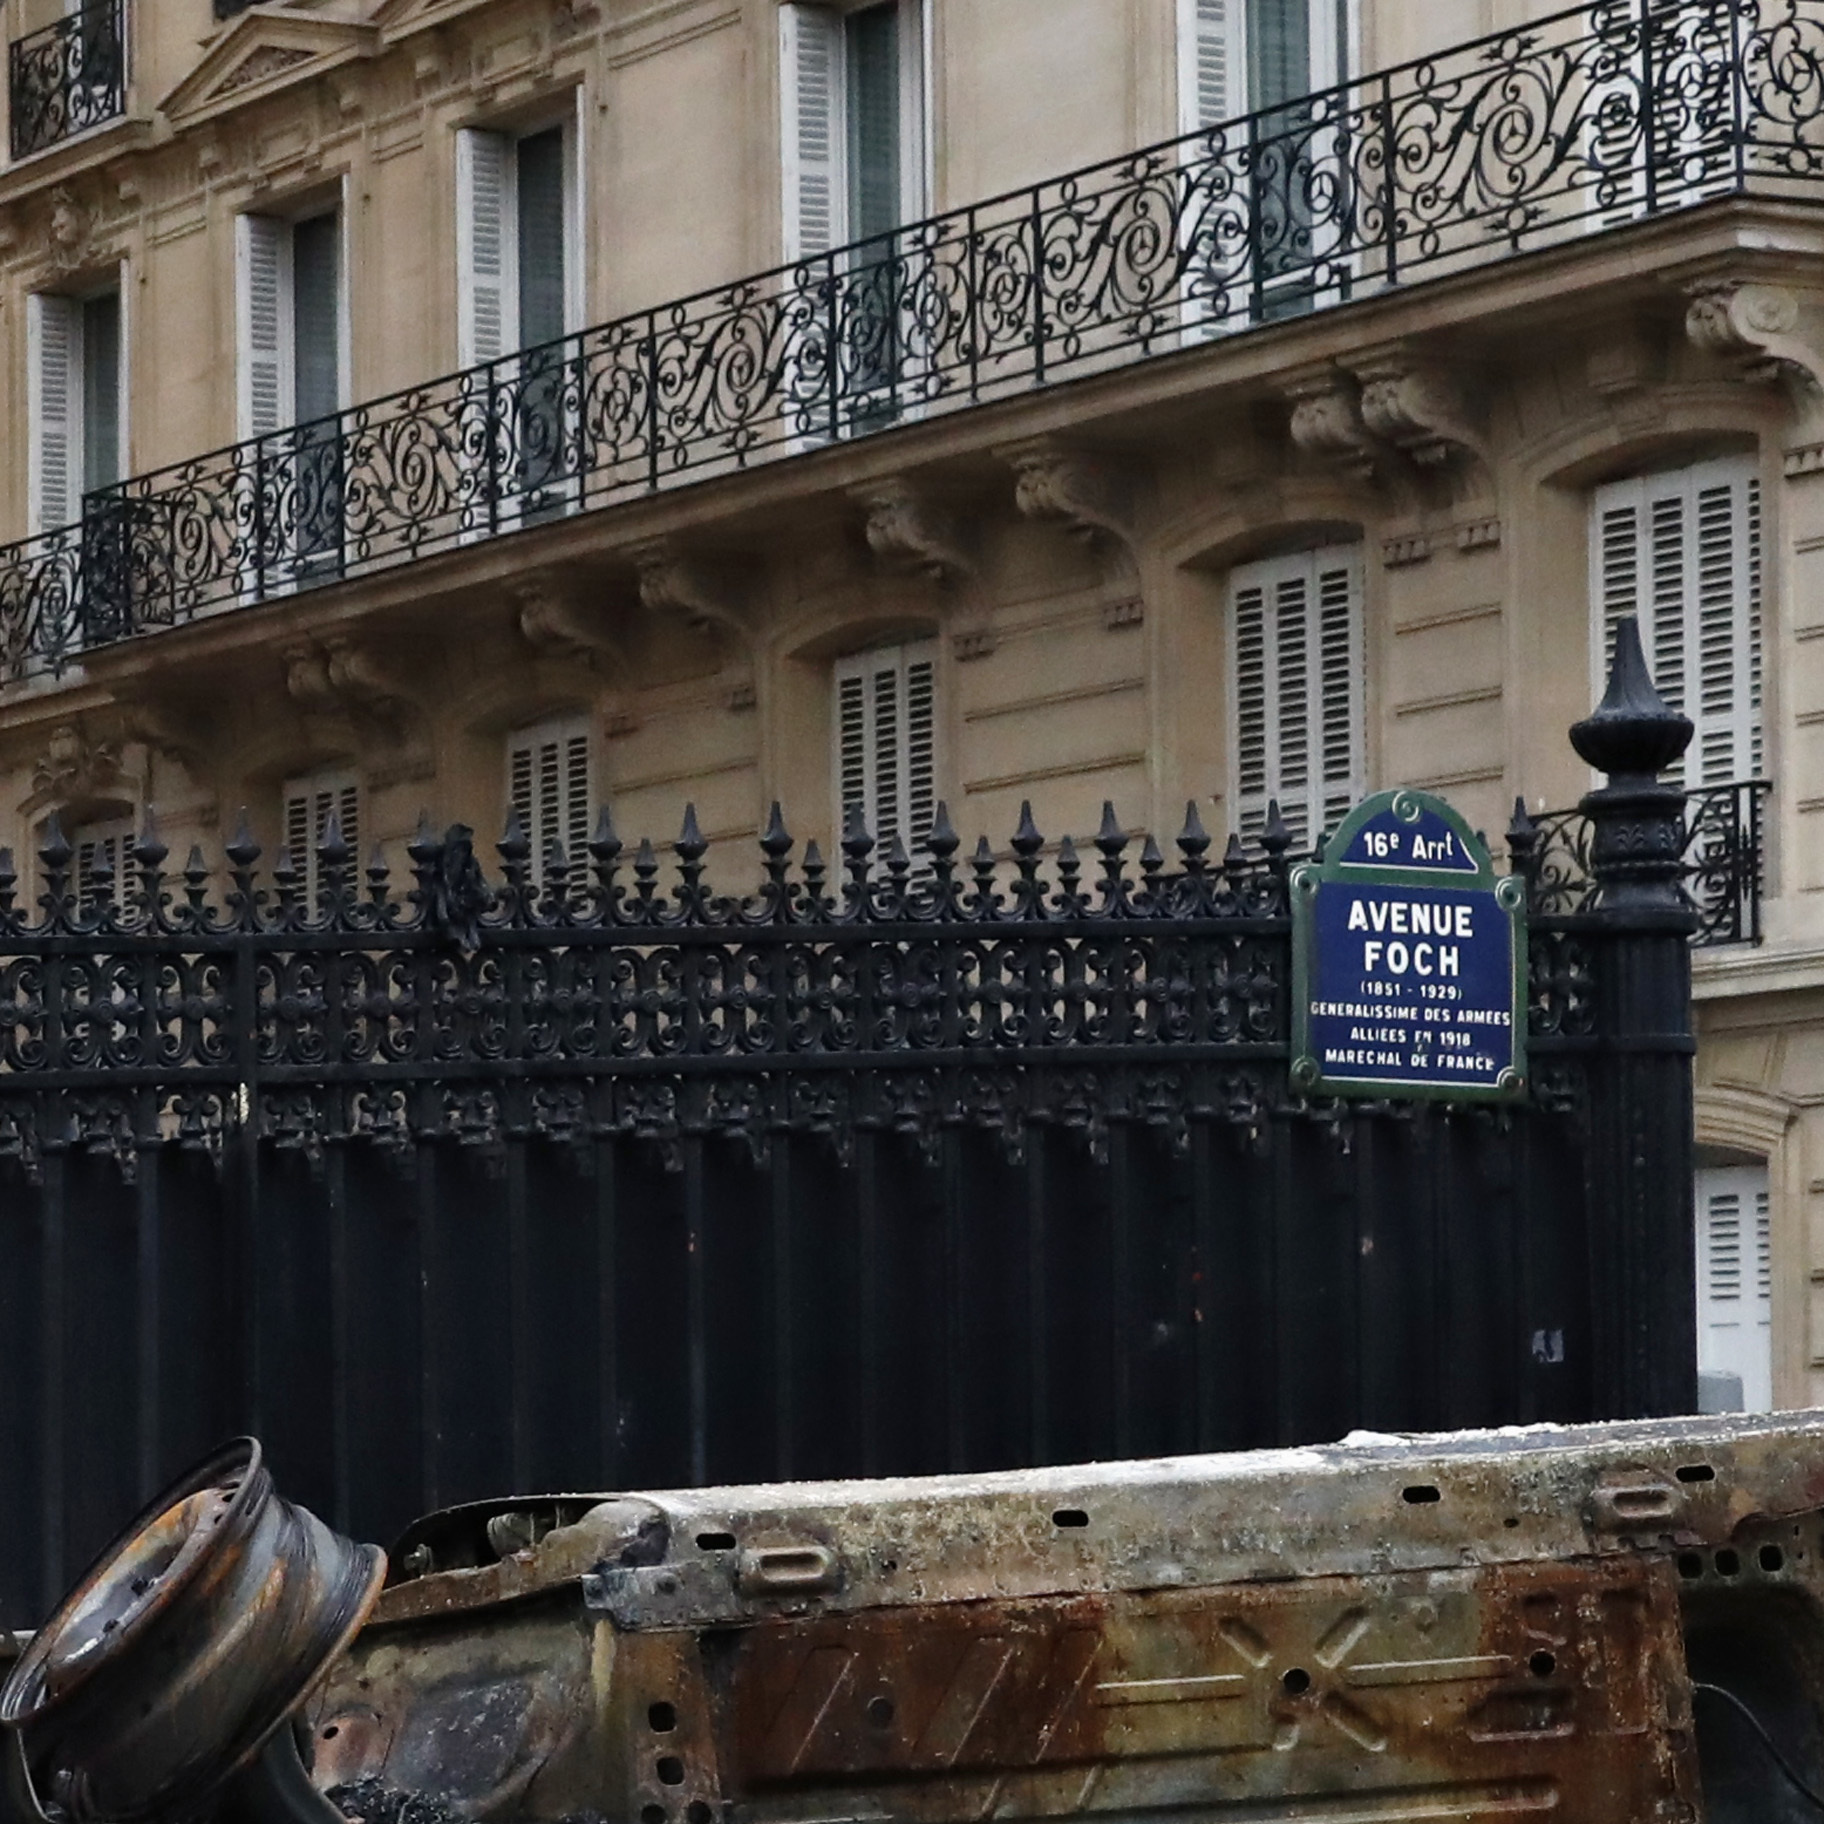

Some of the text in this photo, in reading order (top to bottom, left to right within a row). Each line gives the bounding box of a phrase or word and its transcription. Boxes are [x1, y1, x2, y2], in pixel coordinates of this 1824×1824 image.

[1363, 830, 1454, 861] 16e Arrt
[1347, 900, 1474, 937] AVENUE
[1364, 941, 1459, 977] FOCH
[1424, 1008, 1450, 1022] DES
[1440, 1032, 1471, 1047] 1918
[1411, 1054, 1429, 1069] DE
[1437, 1055, 1494, 1071] FRANCE
